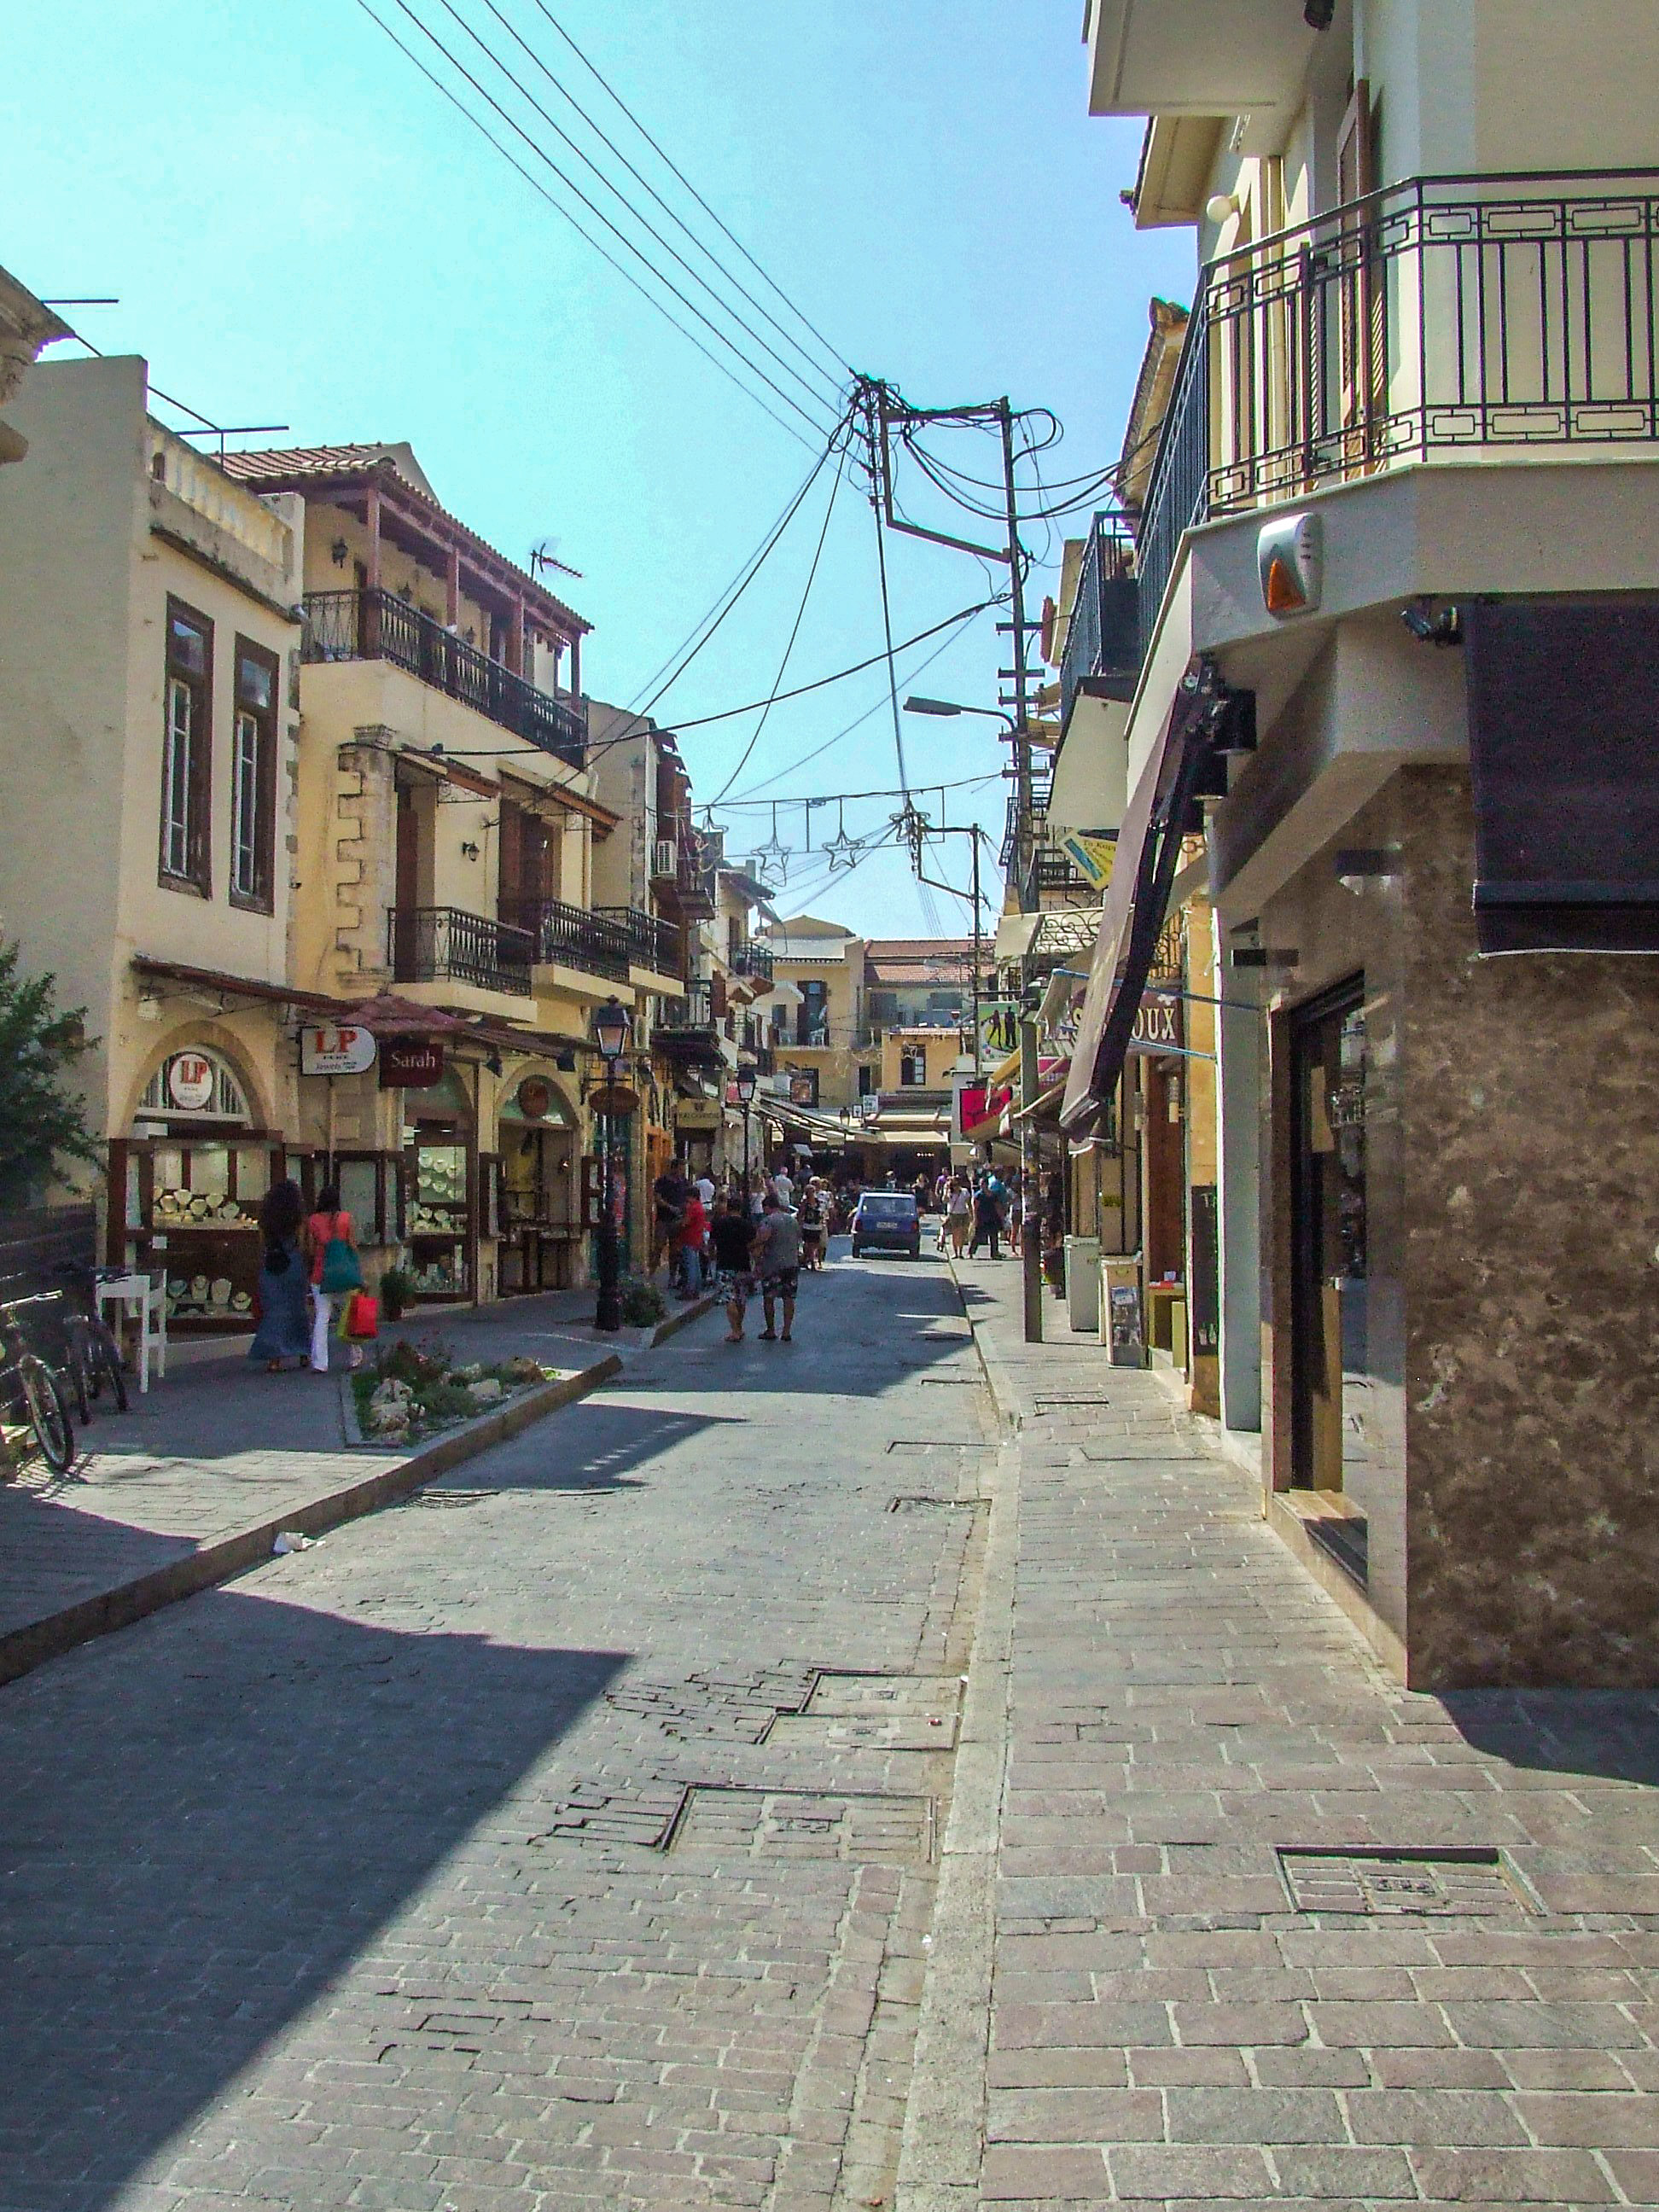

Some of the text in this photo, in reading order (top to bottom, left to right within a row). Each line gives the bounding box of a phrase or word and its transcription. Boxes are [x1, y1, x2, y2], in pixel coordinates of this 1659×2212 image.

[1132, 1007, 1176, 1040] OUX
[315, 1029, 358, 1054] LP
[392, 1050, 436, 1068] Sarah
[180, 1061, 208, 1084] LP
